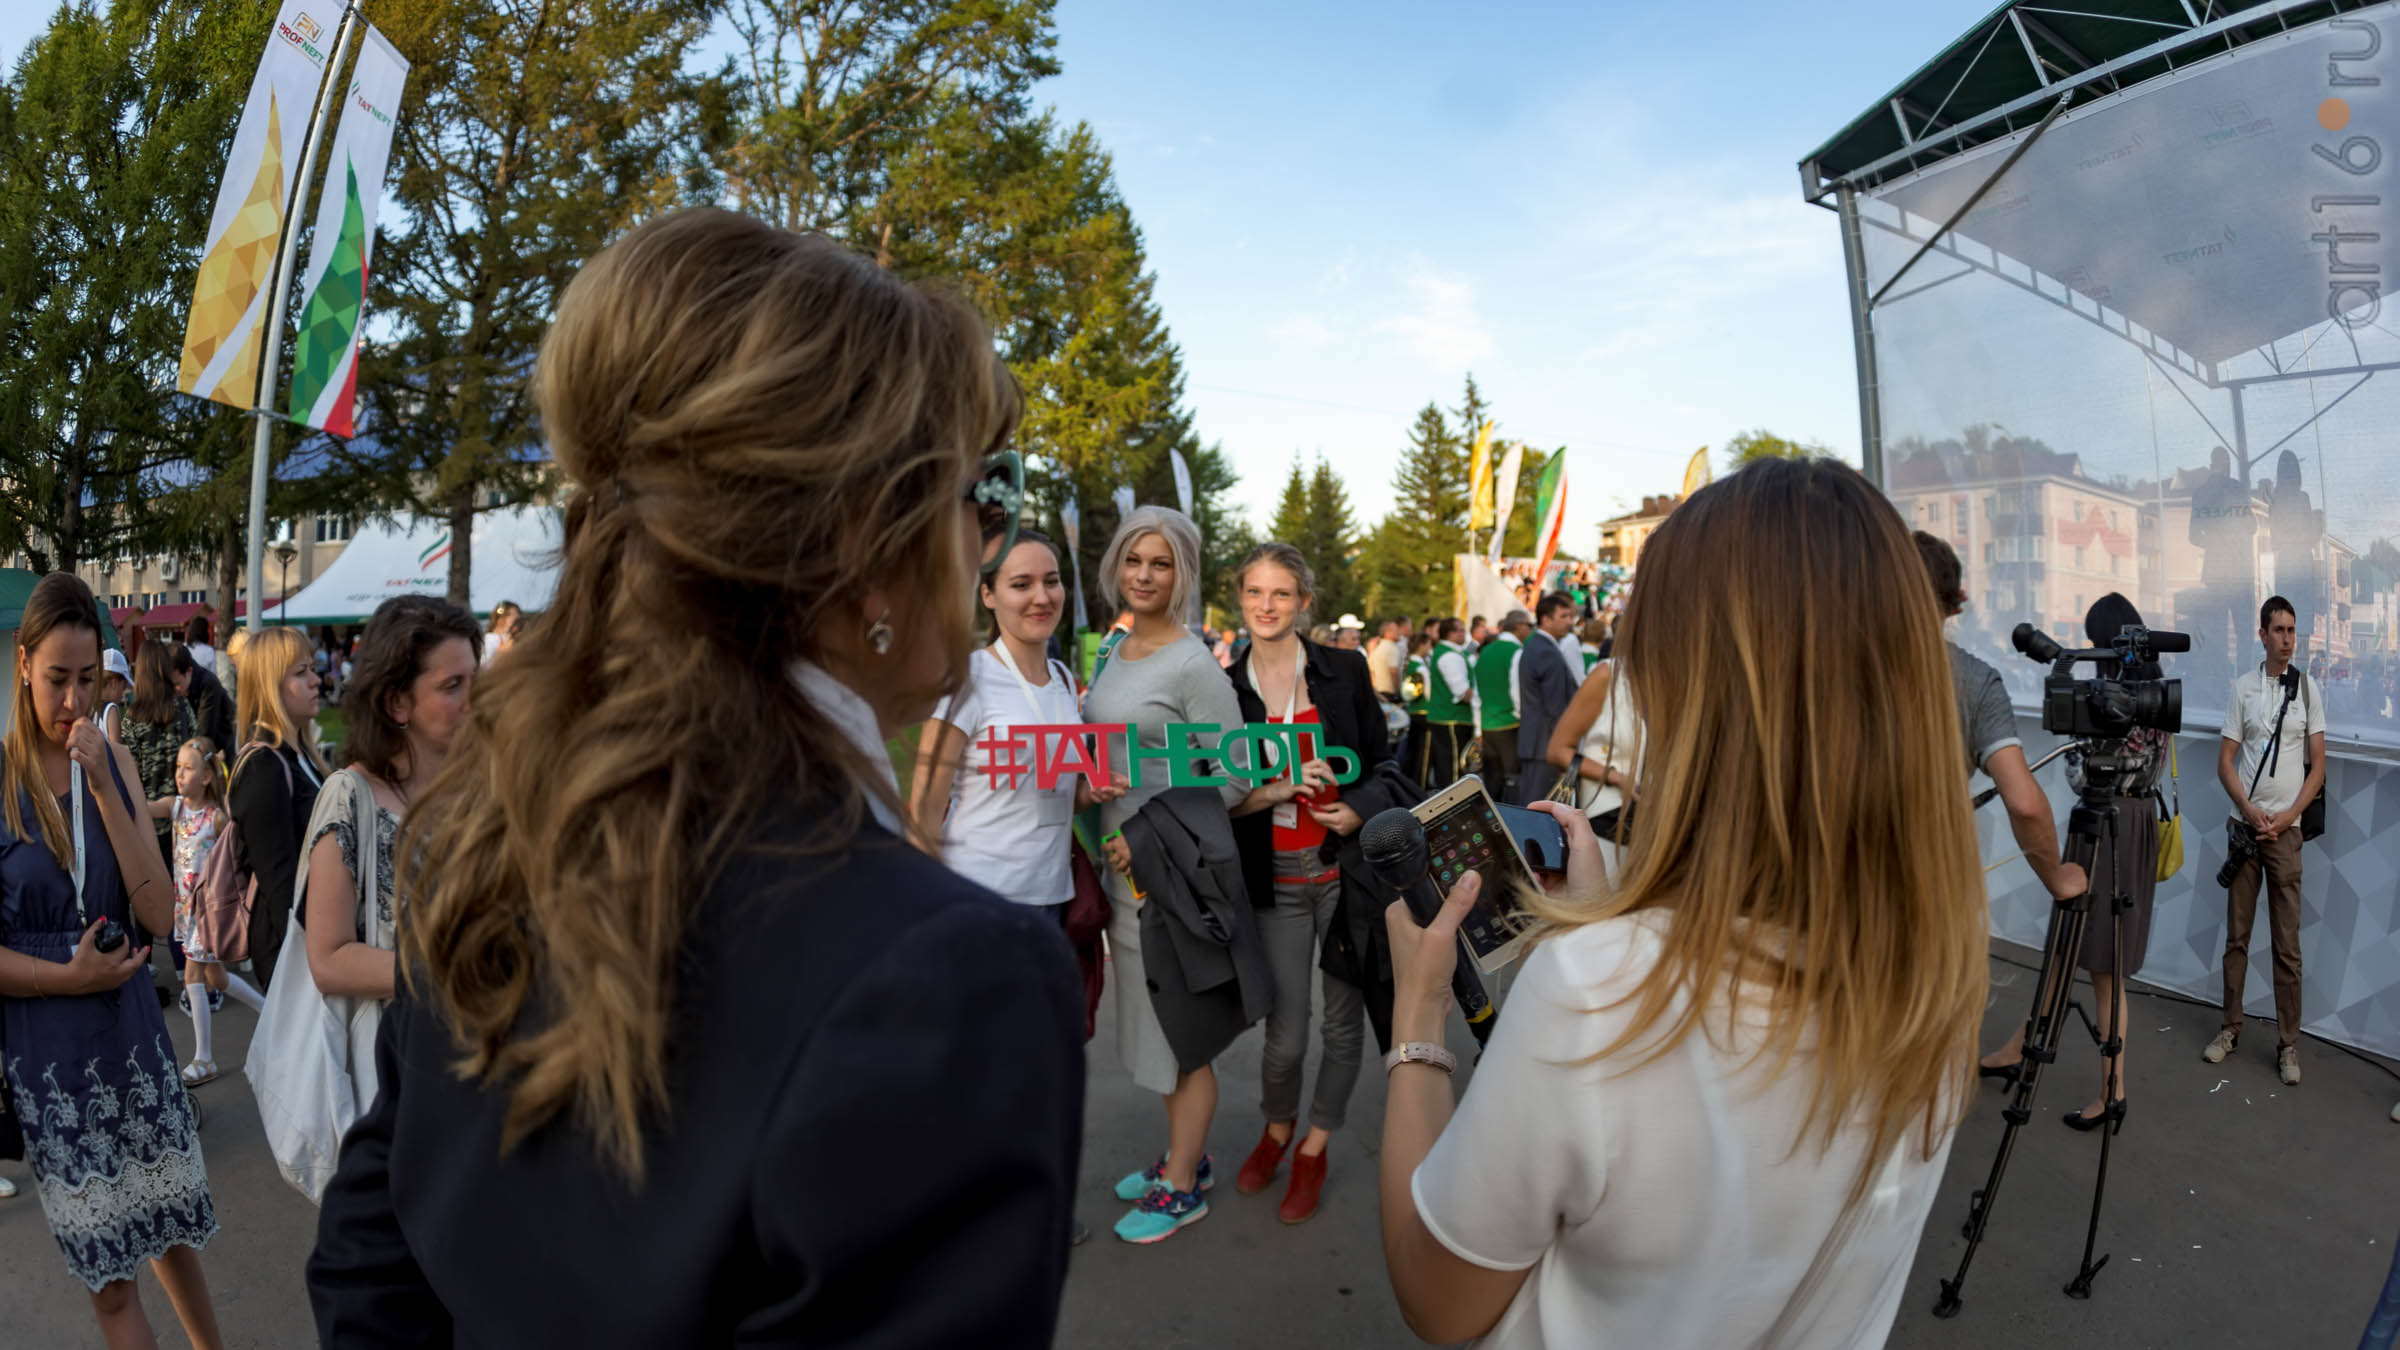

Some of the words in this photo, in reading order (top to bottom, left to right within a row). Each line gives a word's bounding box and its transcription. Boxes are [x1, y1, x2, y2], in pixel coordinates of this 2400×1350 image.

[279, 21, 325, 63] PROFNEFT
[358, 95, 392, 128] TATNEFT
[976, 722, 1362, 790] #ТАТНЕФТЬ
